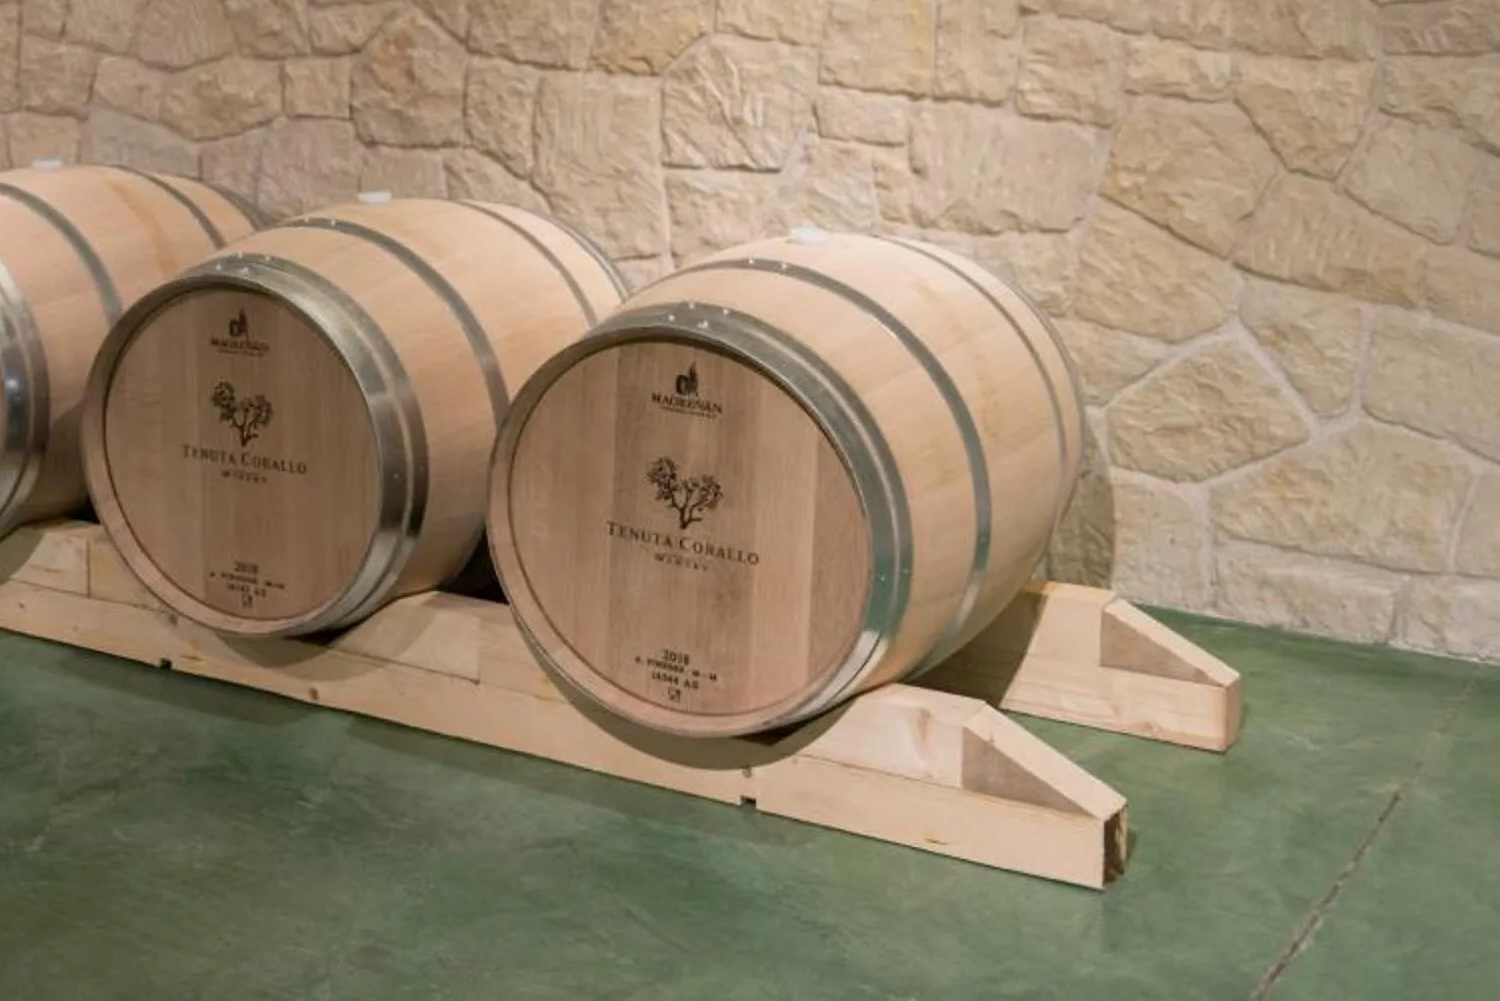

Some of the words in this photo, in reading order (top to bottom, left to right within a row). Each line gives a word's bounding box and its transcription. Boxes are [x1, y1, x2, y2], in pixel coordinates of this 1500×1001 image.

[182, 443, 238, 466] TENUTA
[240, 451, 308, 475] CORALLO
[605, 520, 674, 548] TENUTA
[679, 536, 760, 566] CORALLO
